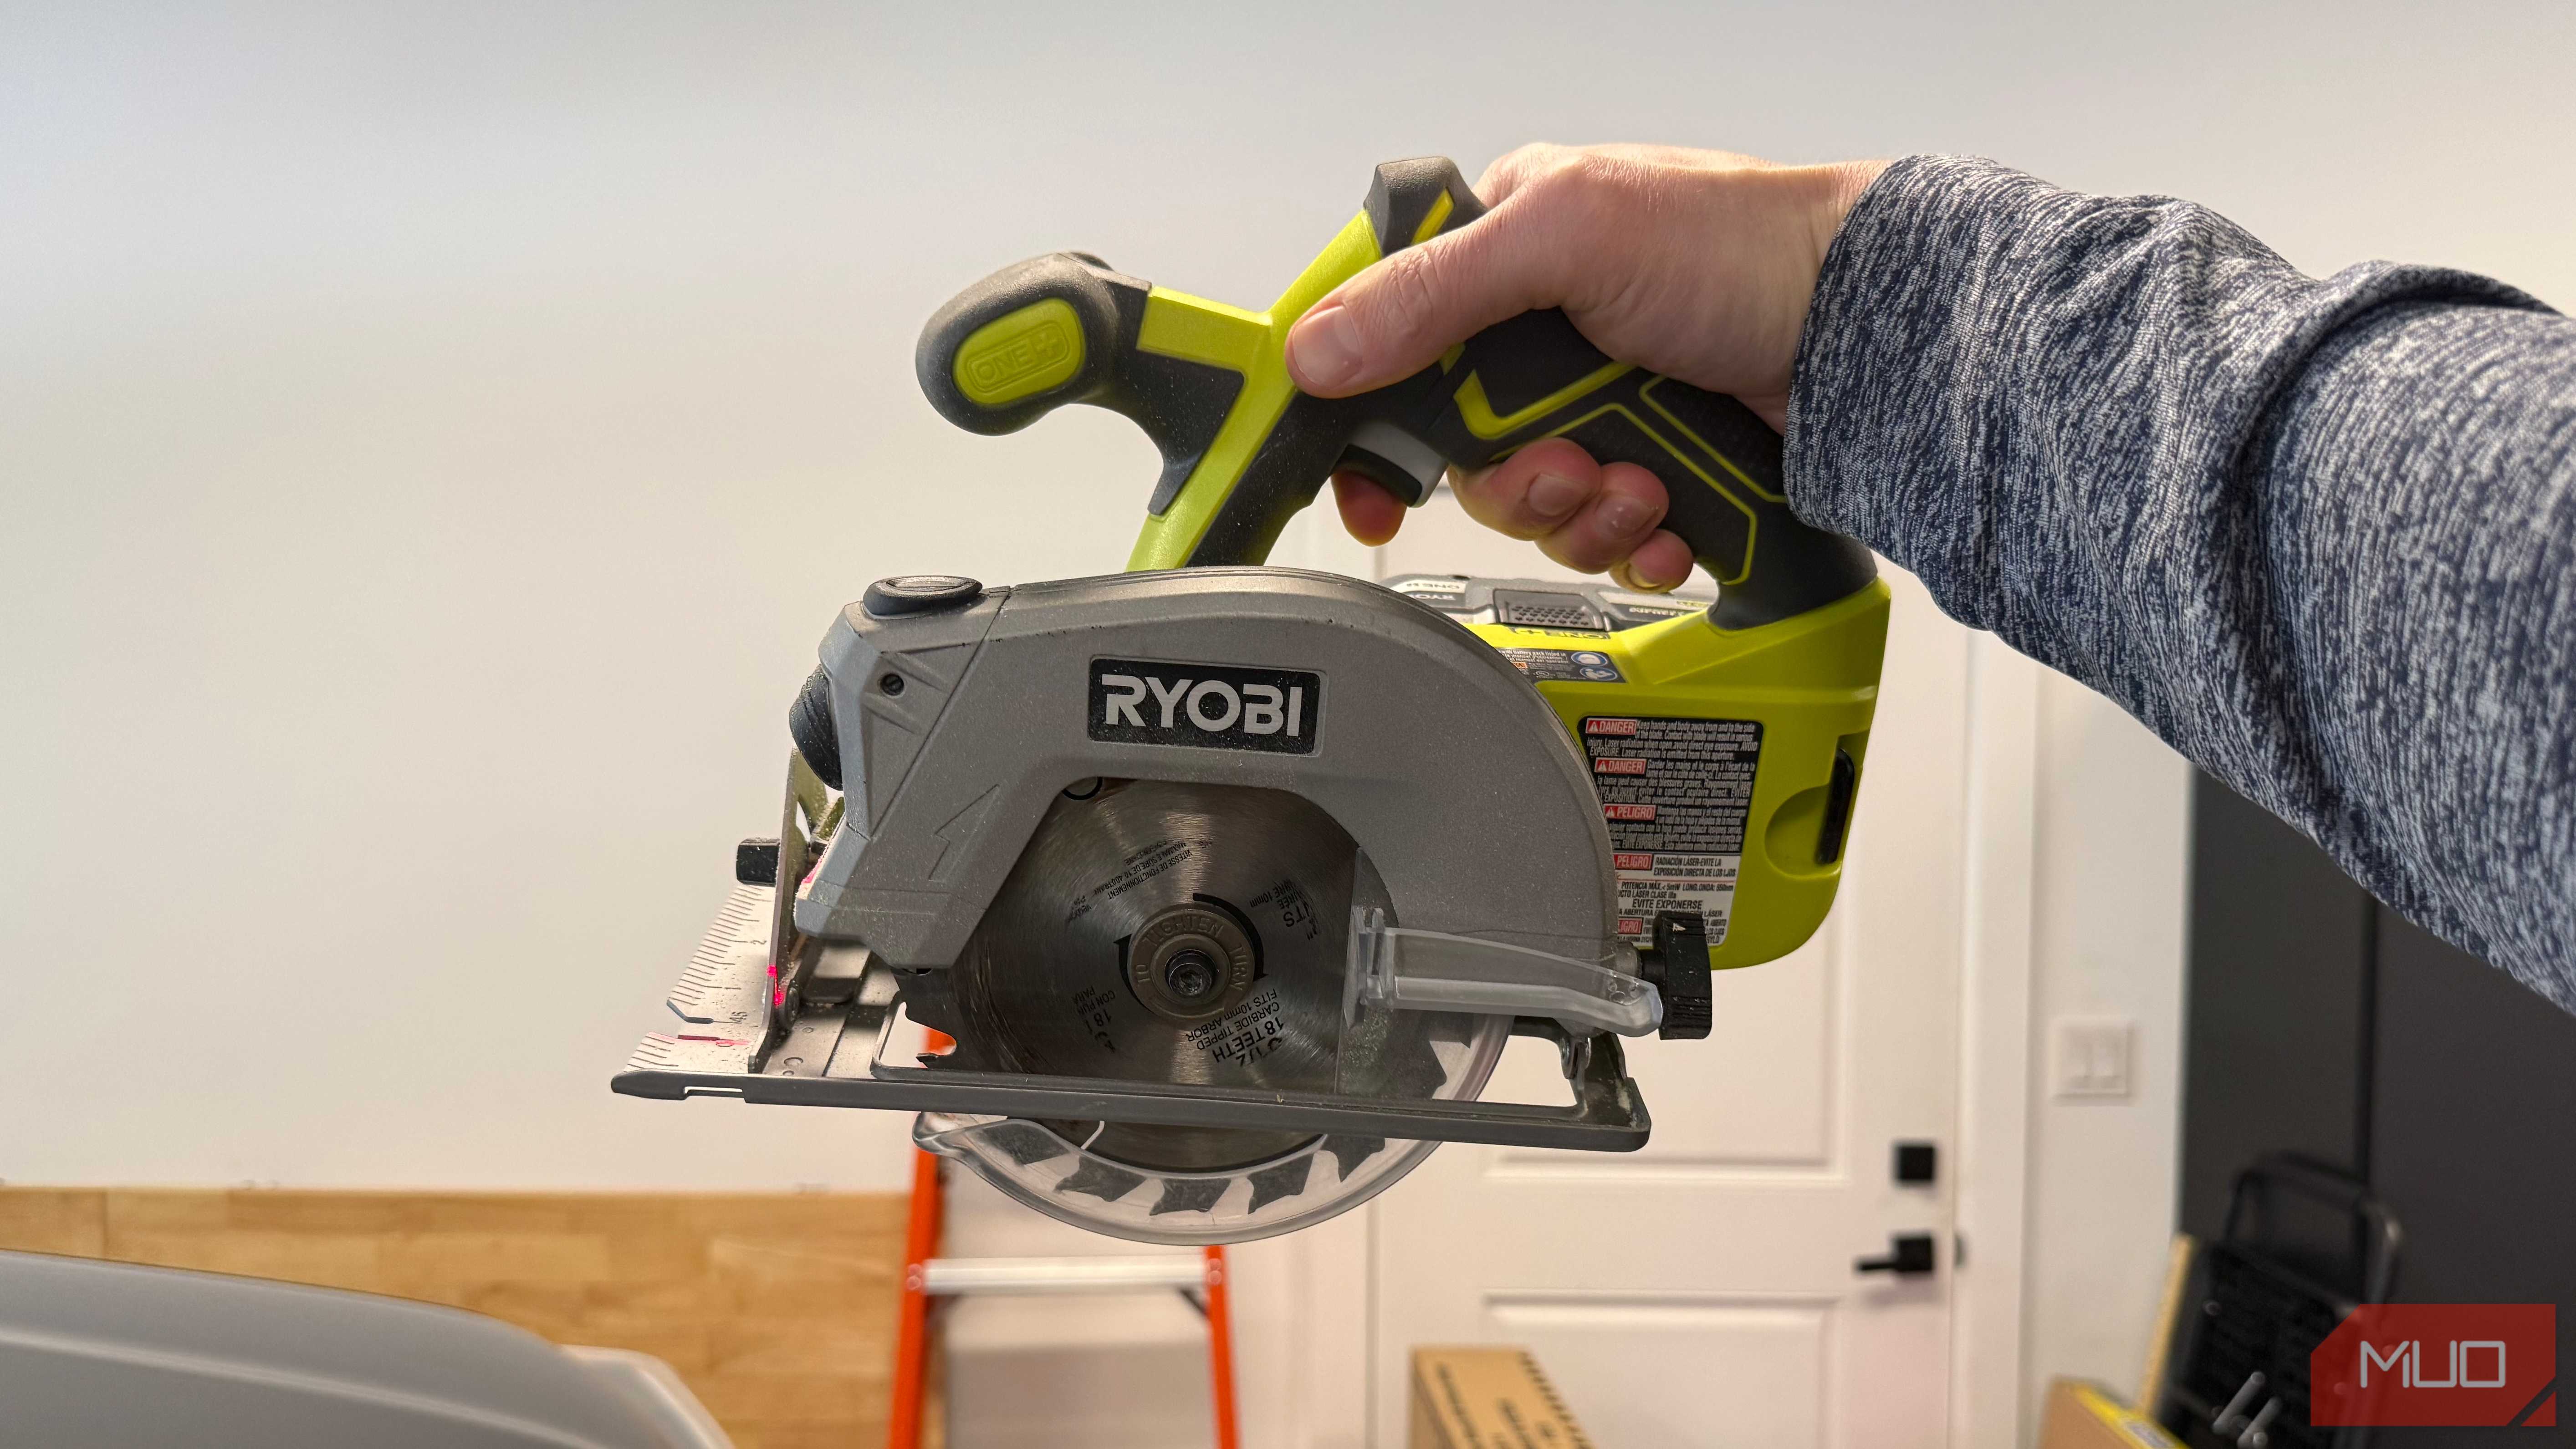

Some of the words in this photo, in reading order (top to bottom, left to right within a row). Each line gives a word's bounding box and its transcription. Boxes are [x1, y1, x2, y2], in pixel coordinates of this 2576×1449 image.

[1102, 674, 1303, 737] RYOBI
[1599, 721, 1635, 733] DANGER
[1650, 720, 1666, 730] hands
[1740, 742, 1758, 751] AVOID
[1608, 760, 1643, 773] DANGER
[1617, 807, 1652, 818] PELIGRO
[1170, 849, 1193, 867] VITESSE
[1617, 856, 1649, 868] PELIGRO
[1684, 868, 1704, 877] DIRECTA
[1705, 868, 1712, 877] DE
[1713, 868, 1723, 877] LOS
[1108, 868, 1160, 900] FONCTIONNEMENT
[1621, 881, 1647, 889] POTENCIA
[1249, 891, 1272, 908] 10mm
[1632, 898, 1654, 908] EVITE
[1656, 899, 1703, 909] EXPONERSE
[1142, 915, 1224, 947] TIGHTEN
[1230, 943, 1248, 991] TURN
[1096, 990, 1115, 1006] CON
[1253, 989, 1278, 1007] FITS
[1224, 1002, 1252, 1020] 10mm
[1234, 1002, 1279, 1031] CARBIDE
[1186, 1017, 1222, 1041] ARBOR
[1264, 1017, 1284, 1035] 18
[1196, 1026, 1234, 1050] TIPPED
[1212, 1027, 1265, 1062] TEETH
